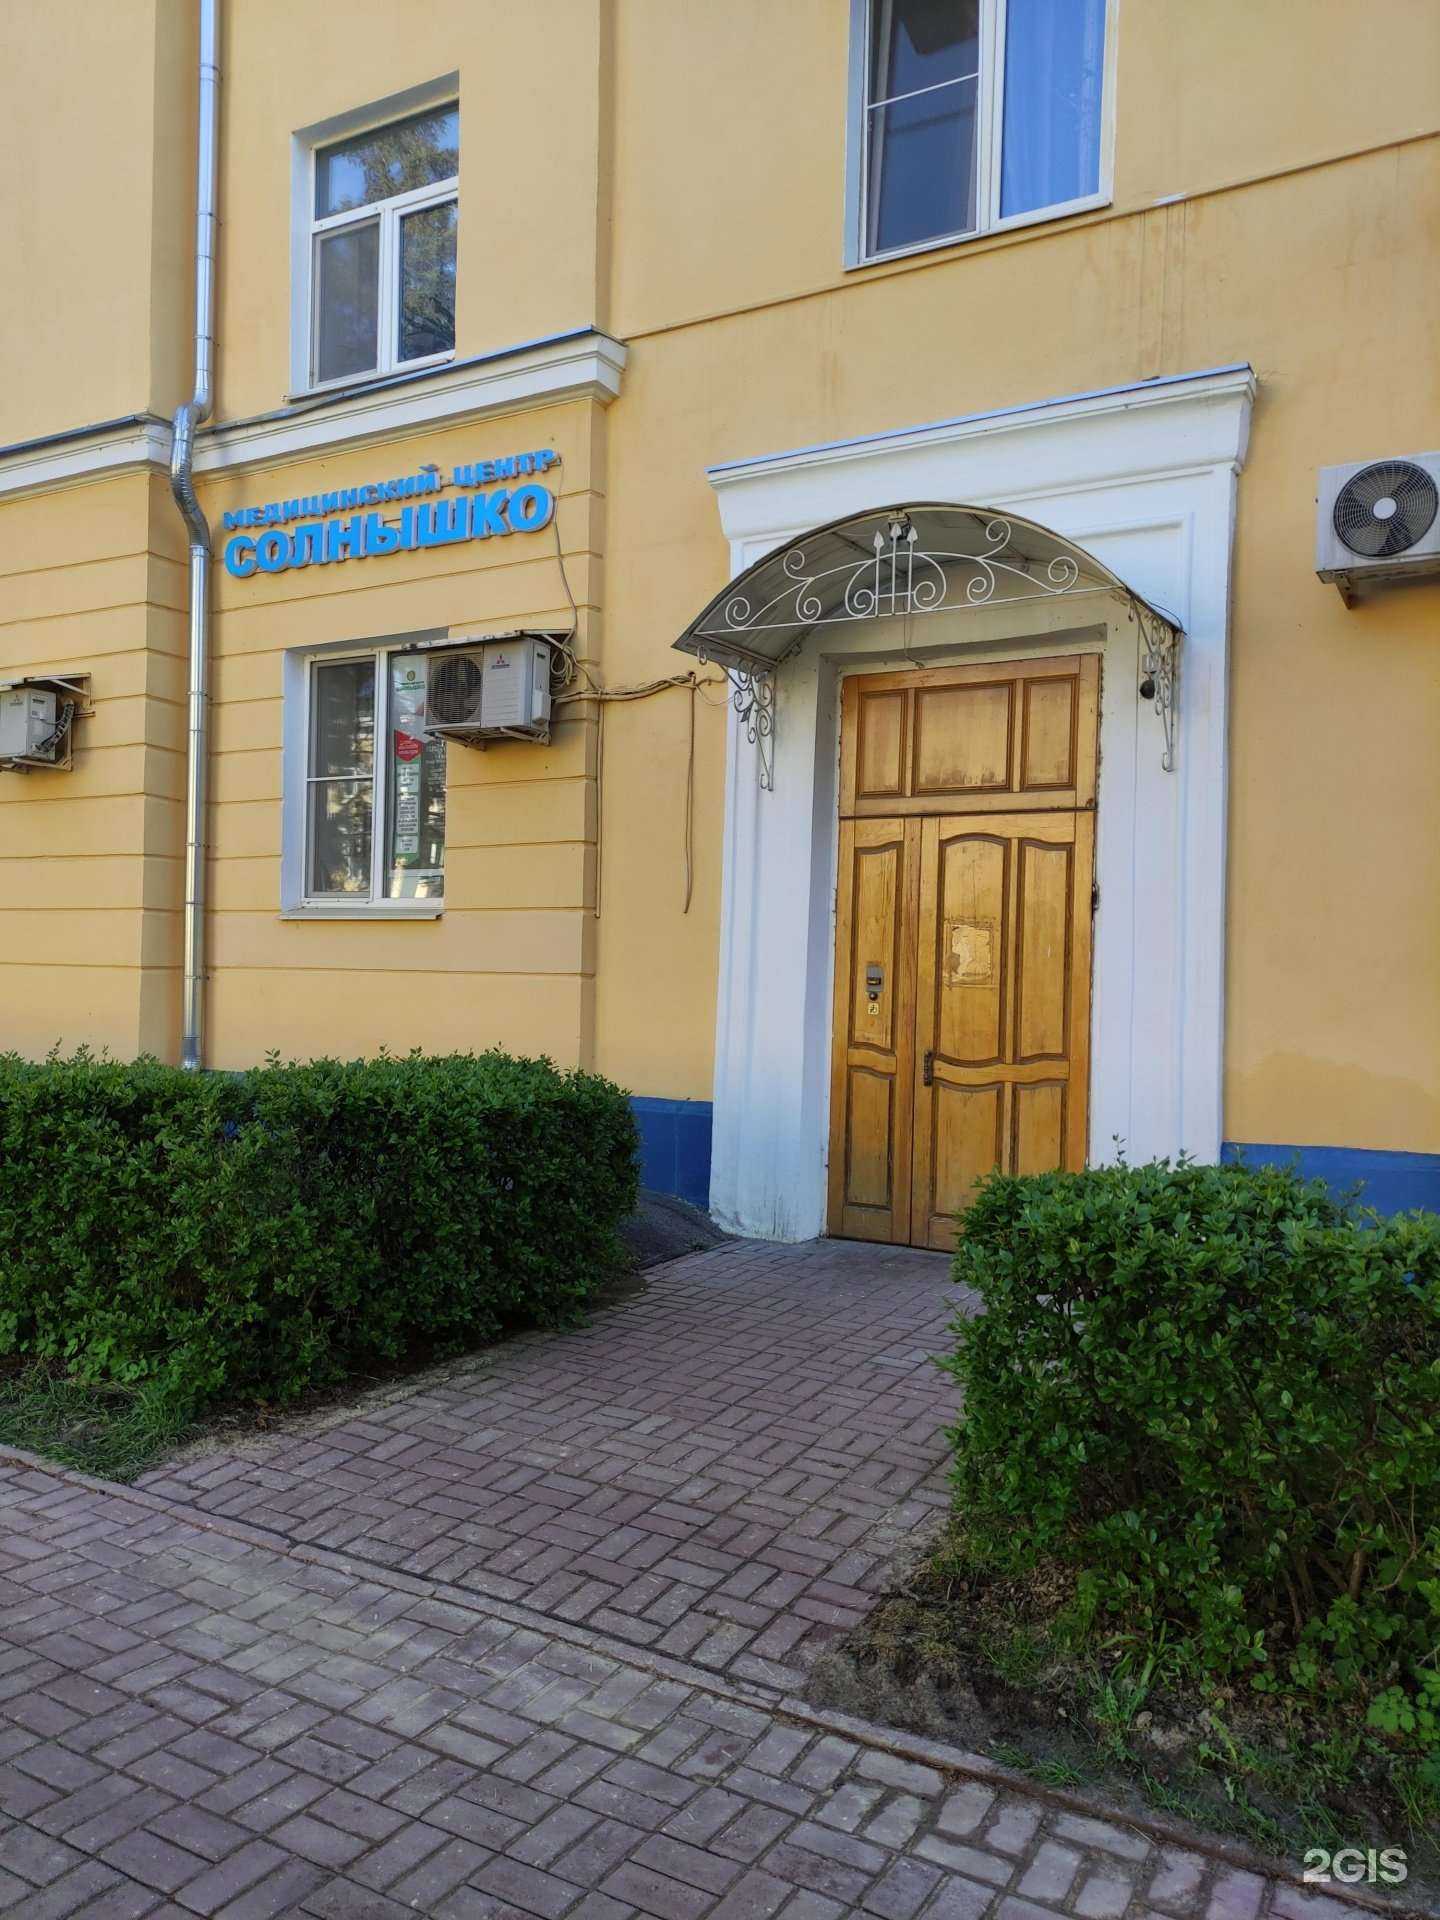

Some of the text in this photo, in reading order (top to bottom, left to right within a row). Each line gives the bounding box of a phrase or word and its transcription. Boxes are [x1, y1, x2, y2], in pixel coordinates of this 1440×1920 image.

[223, 448, 558, 531] МЕДИЦИНСКИЙ ЦЕНТР
[224, 483, 555, 578] СОЛНЫШКО
